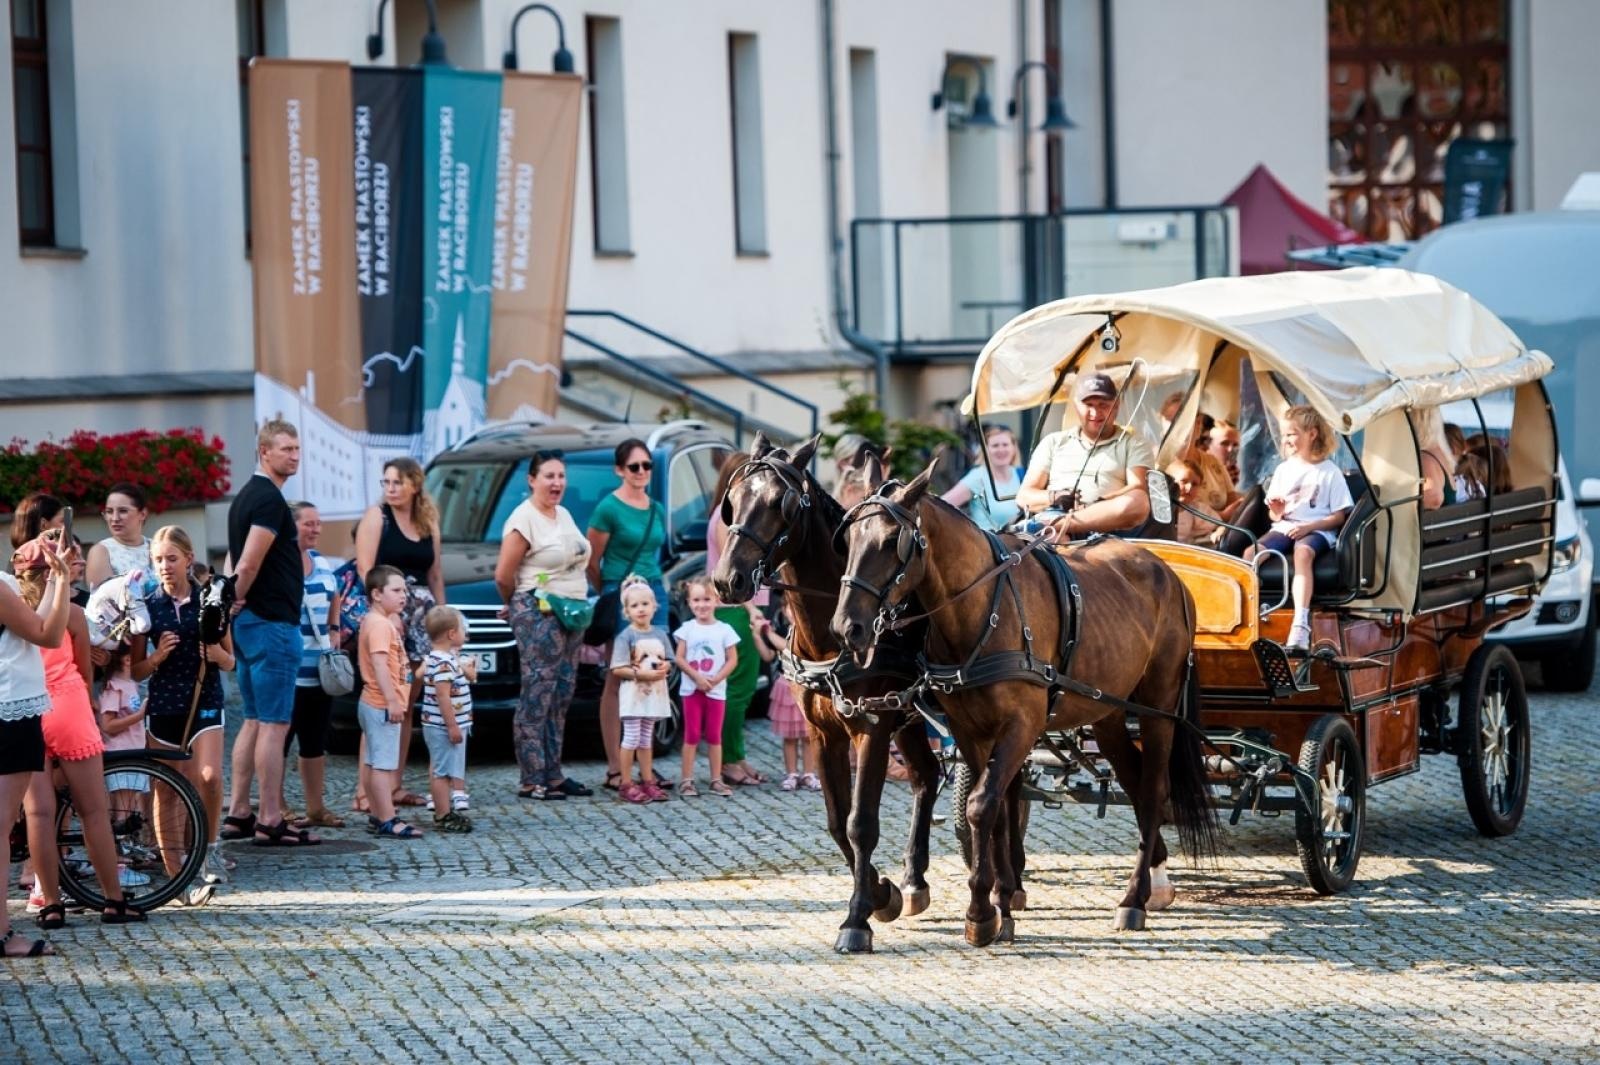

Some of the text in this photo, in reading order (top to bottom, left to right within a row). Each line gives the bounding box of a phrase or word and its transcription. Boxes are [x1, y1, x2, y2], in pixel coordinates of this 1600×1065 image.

[287, 99, 306, 293] ZAMEK PIASTOWSKI
[305, 157, 322, 294] W RACIBORZU
[355, 106, 371, 295] ZAMEK PIASTOWSKI
[373, 162, 389, 296] W RACIBORZU
[436, 106, 455, 291] ZAMEK PIASTOWSKI
[453, 162, 470, 293] W RACIBORZU
[511, 163, 534, 291] W RACIBORZU
